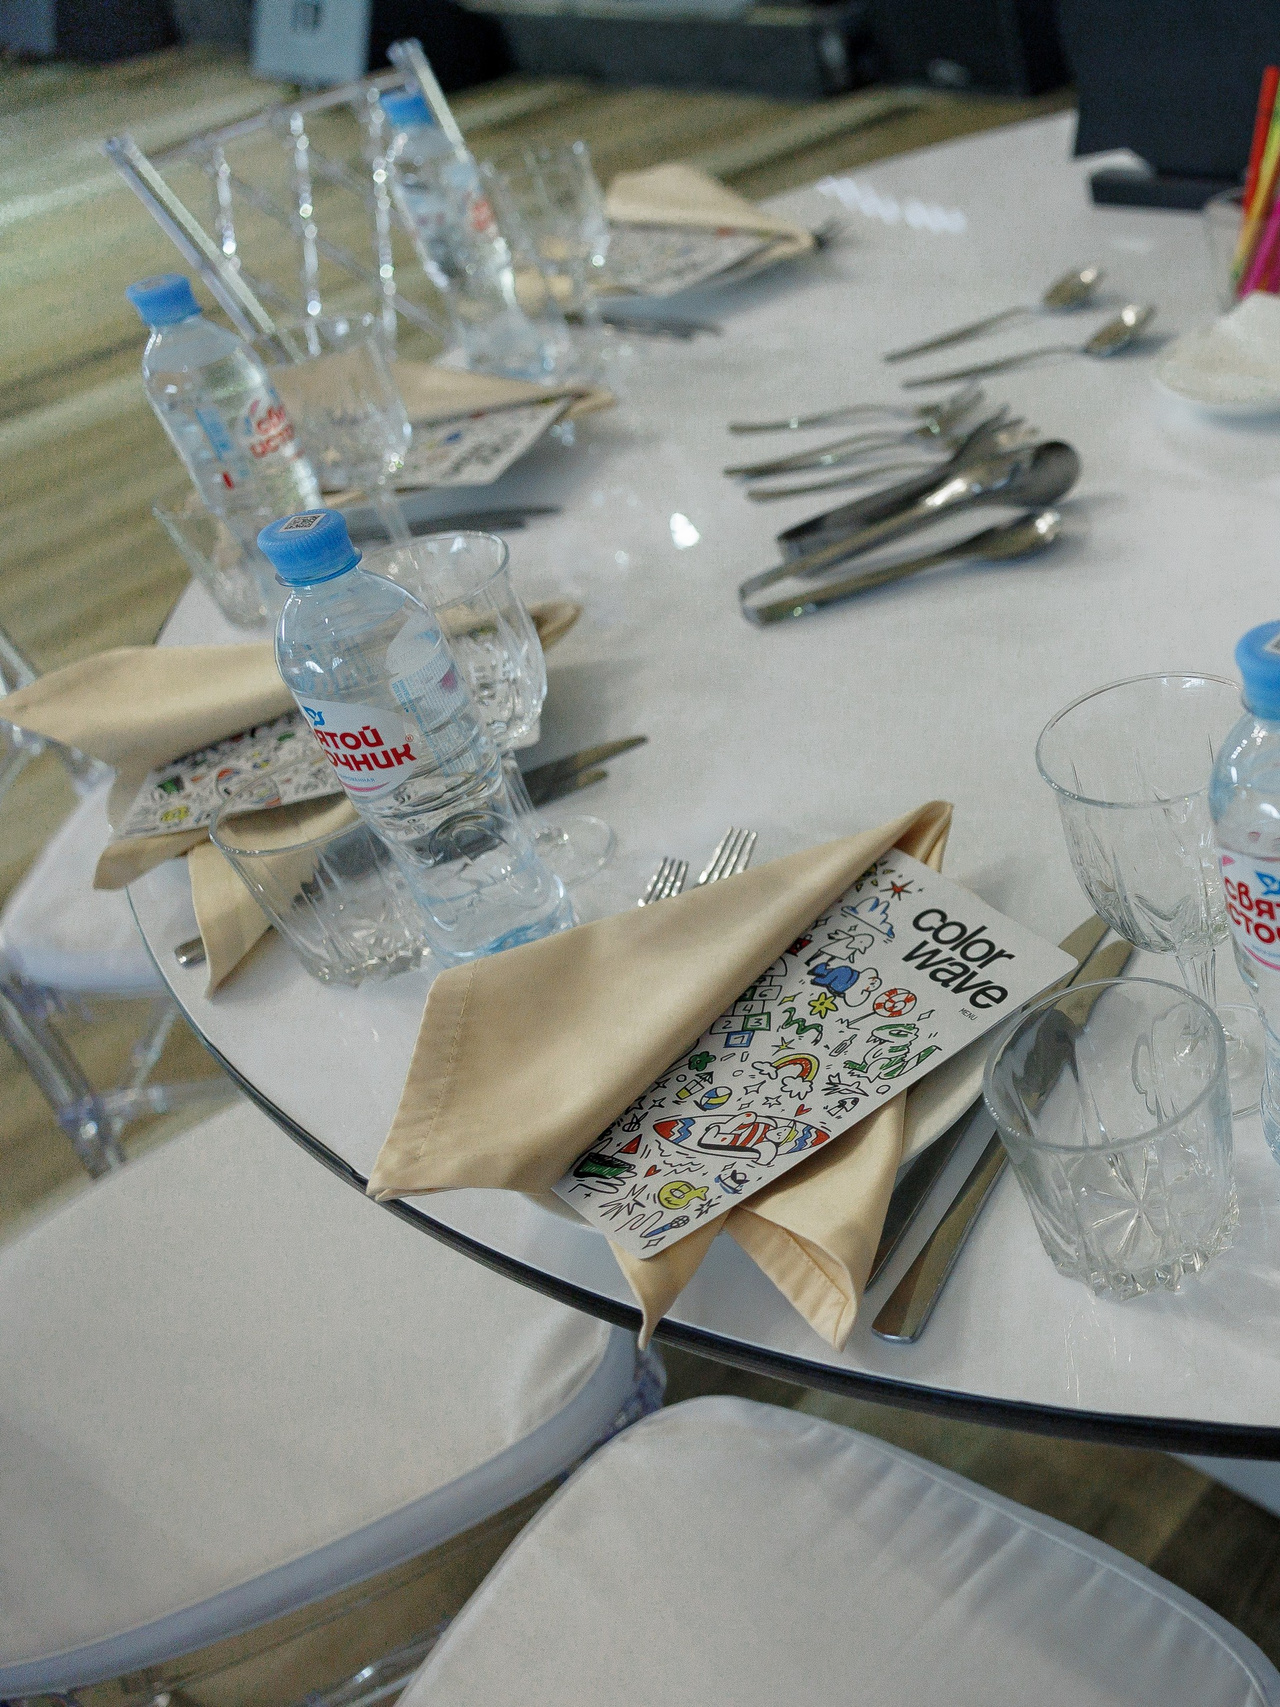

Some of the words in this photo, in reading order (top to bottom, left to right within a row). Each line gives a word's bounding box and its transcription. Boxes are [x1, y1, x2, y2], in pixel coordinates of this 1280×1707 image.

[913, 908, 1015, 969] color
[902, 940, 1008, 1009] wave
[959, 1007, 978, 1020] MENU
